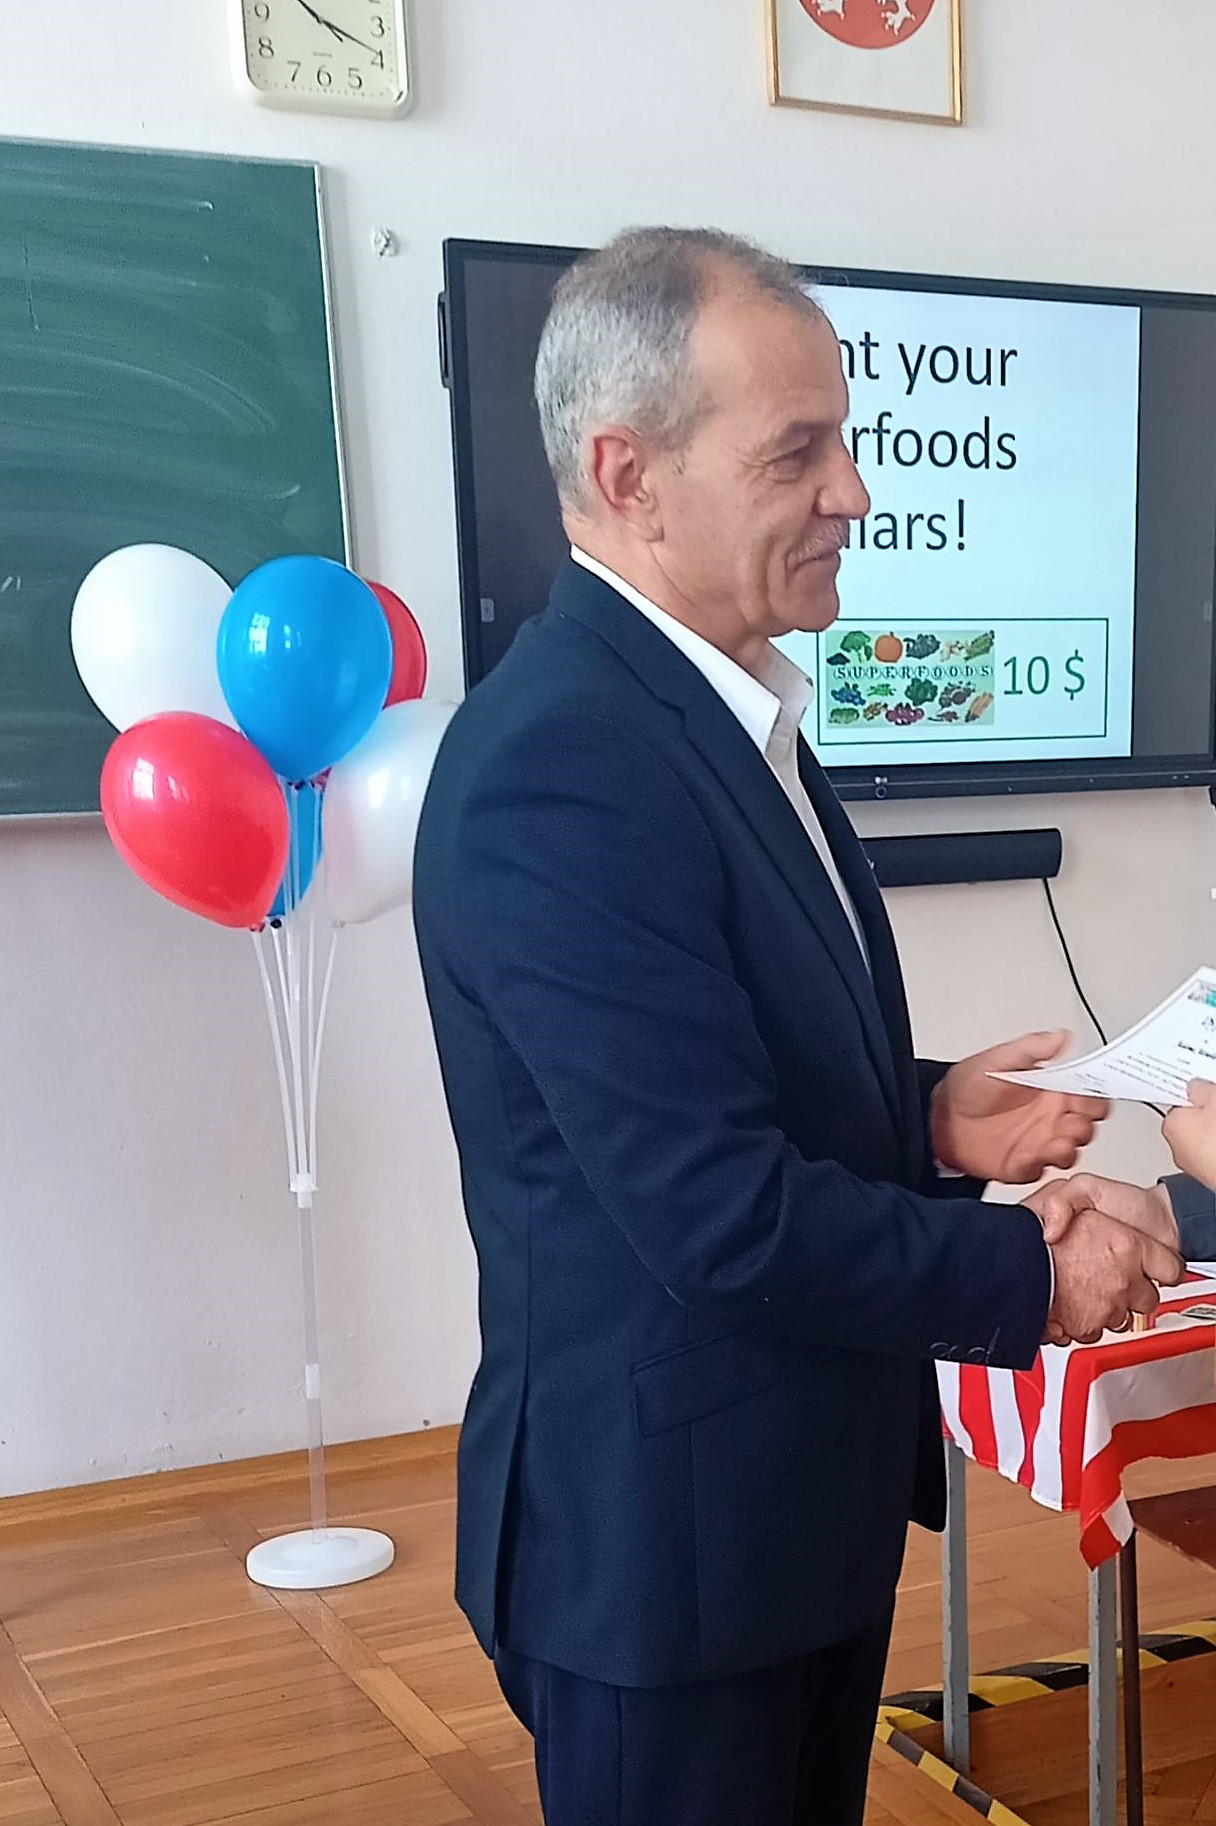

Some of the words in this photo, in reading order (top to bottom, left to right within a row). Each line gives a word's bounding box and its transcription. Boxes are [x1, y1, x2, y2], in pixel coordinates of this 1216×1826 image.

[254, 2, 270, 22] 9
[370, 15, 385, 38] 3
[258, 36, 275, 59] 8
[370, 50, 384, 70] 4
[287, 61, 301, 82] 7
[316, 65, 332, 87] 6
[348, 68, 363, 89] 5
[898, 342, 1018, 396] your
[1003, 655, 1050, 695] 10
[1064, 649, 1086, 701] $
